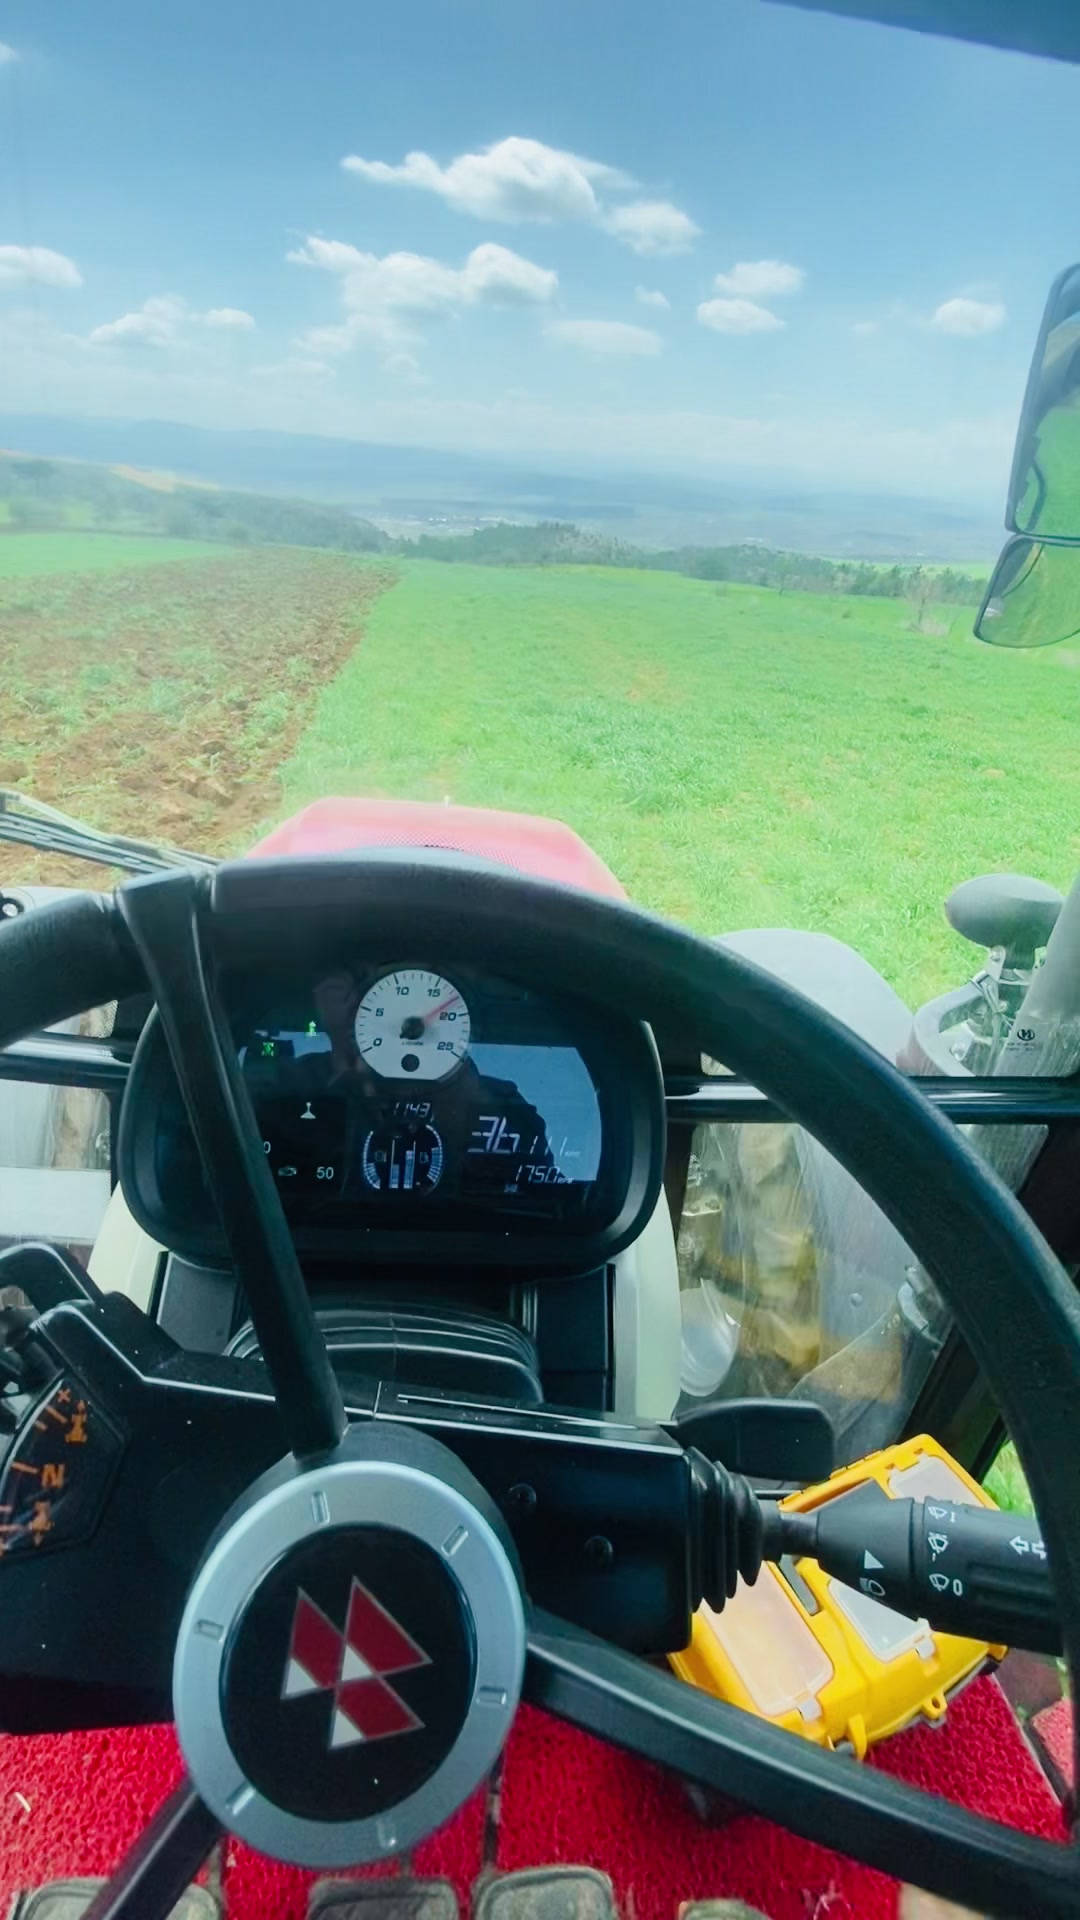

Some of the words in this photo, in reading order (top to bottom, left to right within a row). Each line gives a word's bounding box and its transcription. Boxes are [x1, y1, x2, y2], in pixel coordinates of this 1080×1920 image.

[395, 986, 410, 996] 10
[427, 988, 441, 998] 15
[375, 1007, 384, 1017] 5
[439, 1012, 457, 1022] 20
[373, 1038, 382, 1047] 0
[437, 1041, 454, 1051] 25
[316, 1166, 335, 1180] 50
[42, 1463, 65, 1488] N
